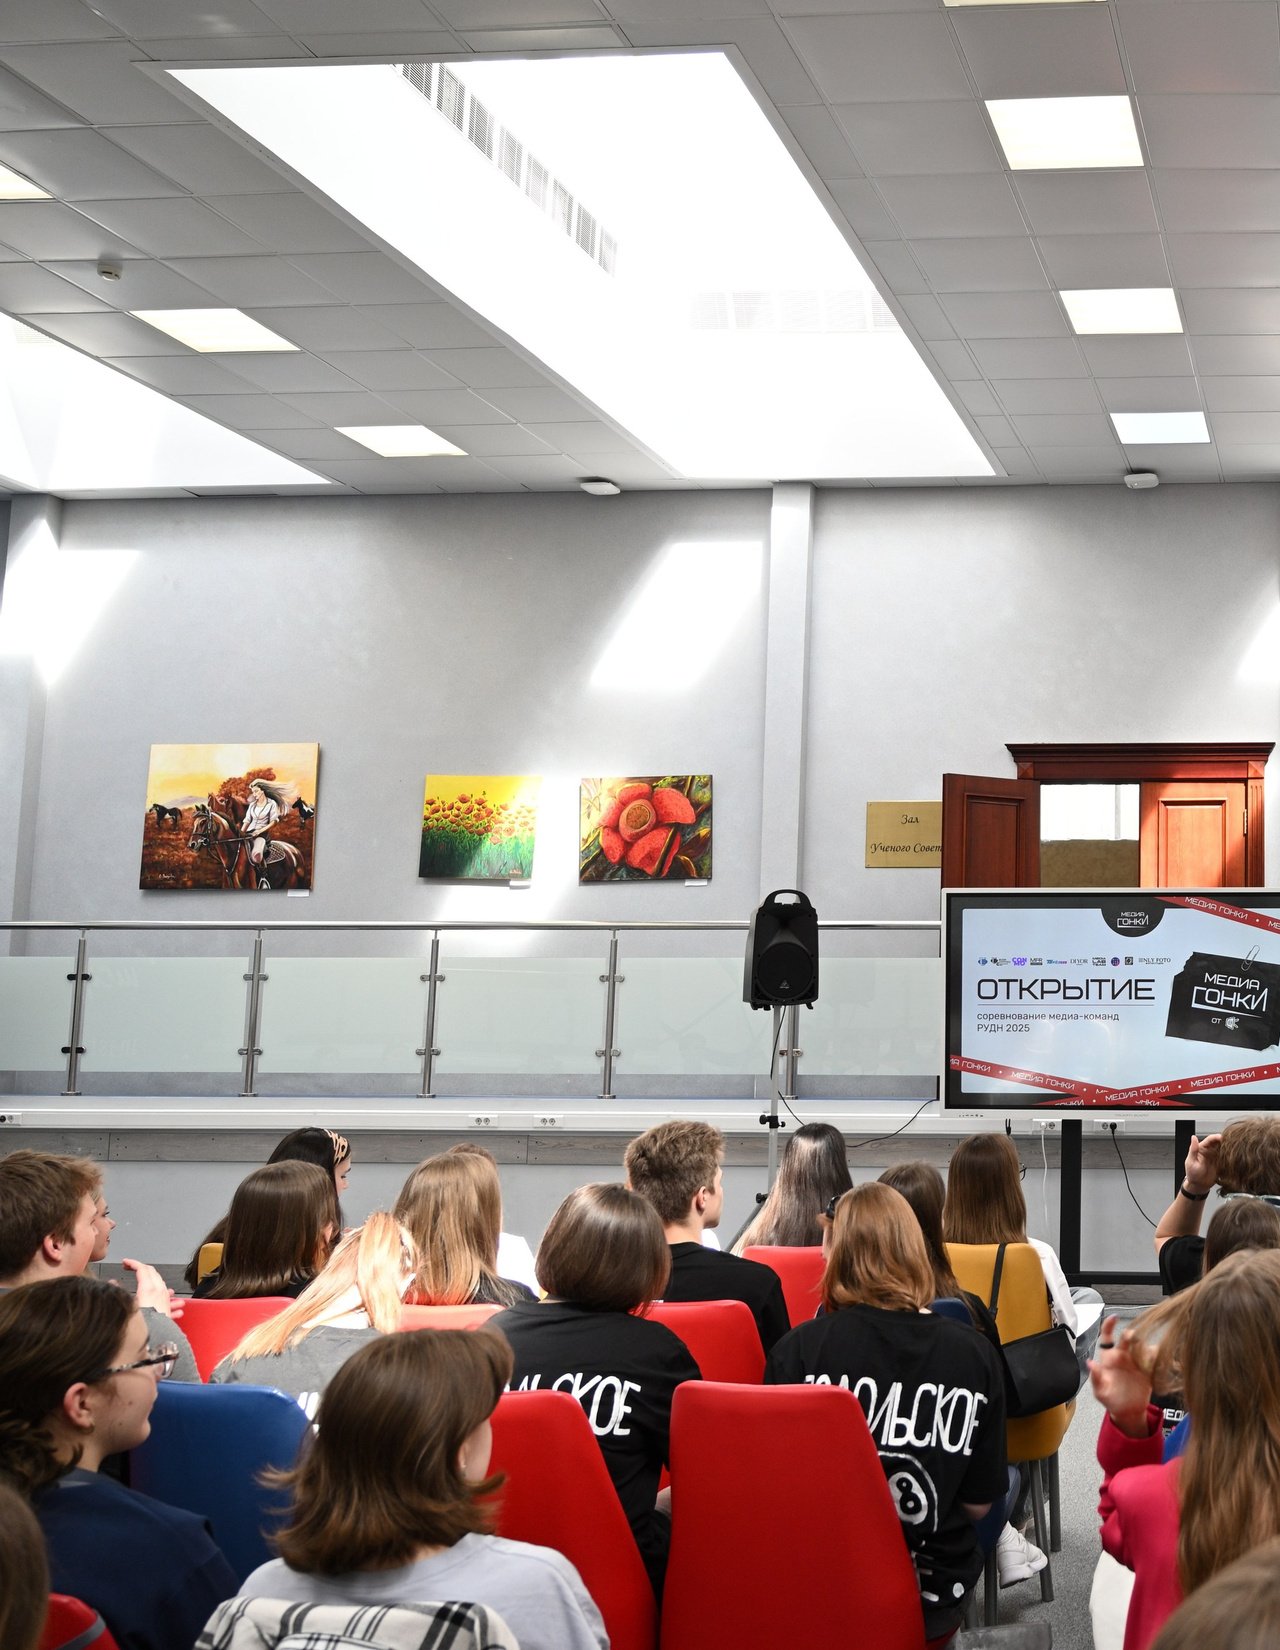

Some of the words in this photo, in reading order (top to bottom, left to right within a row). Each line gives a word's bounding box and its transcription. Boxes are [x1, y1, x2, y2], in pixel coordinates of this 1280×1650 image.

[901, 814, 919, 825] Зал
[870, 842, 911, 854] Ученого
[913, 842, 942, 854] Совет
[1184, 896, 1218, 912] МЕДИА
[1219, 905, 1248, 920] ГОНКИ
[1117, 914, 1149, 928] ГОНКИ
[977, 979, 1156, 1000] ОТКРЫТИЕ
[1204, 972, 1260, 990] МЕДИА
[1191, 986, 1269, 1012] ГОНКИ
[977, 1013, 1046, 1021] соревнование
[1048, 1013, 1120, 1021] медиа-команд
[977, 1024, 1003, 1033] РУДН
[1006, 1024, 1030, 1032] 2025
[961, 1060, 991, 1073] ГОНКИ
[1010, 1070, 1043, 1084] МЕДИА
[1046, 1078, 1075, 1091] ГОНКИ
[1105, 1089, 1138, 1102] МЕДИА
[1139, 1084, 1169, 1096] ГОНКИ
[1190, 1075, 1223, 1088] МЕДИА
[1225, 1069, 1255, 1082] ГОНКИ
[804, 1373, 988, 1456] ОЛЬСКОЕ
